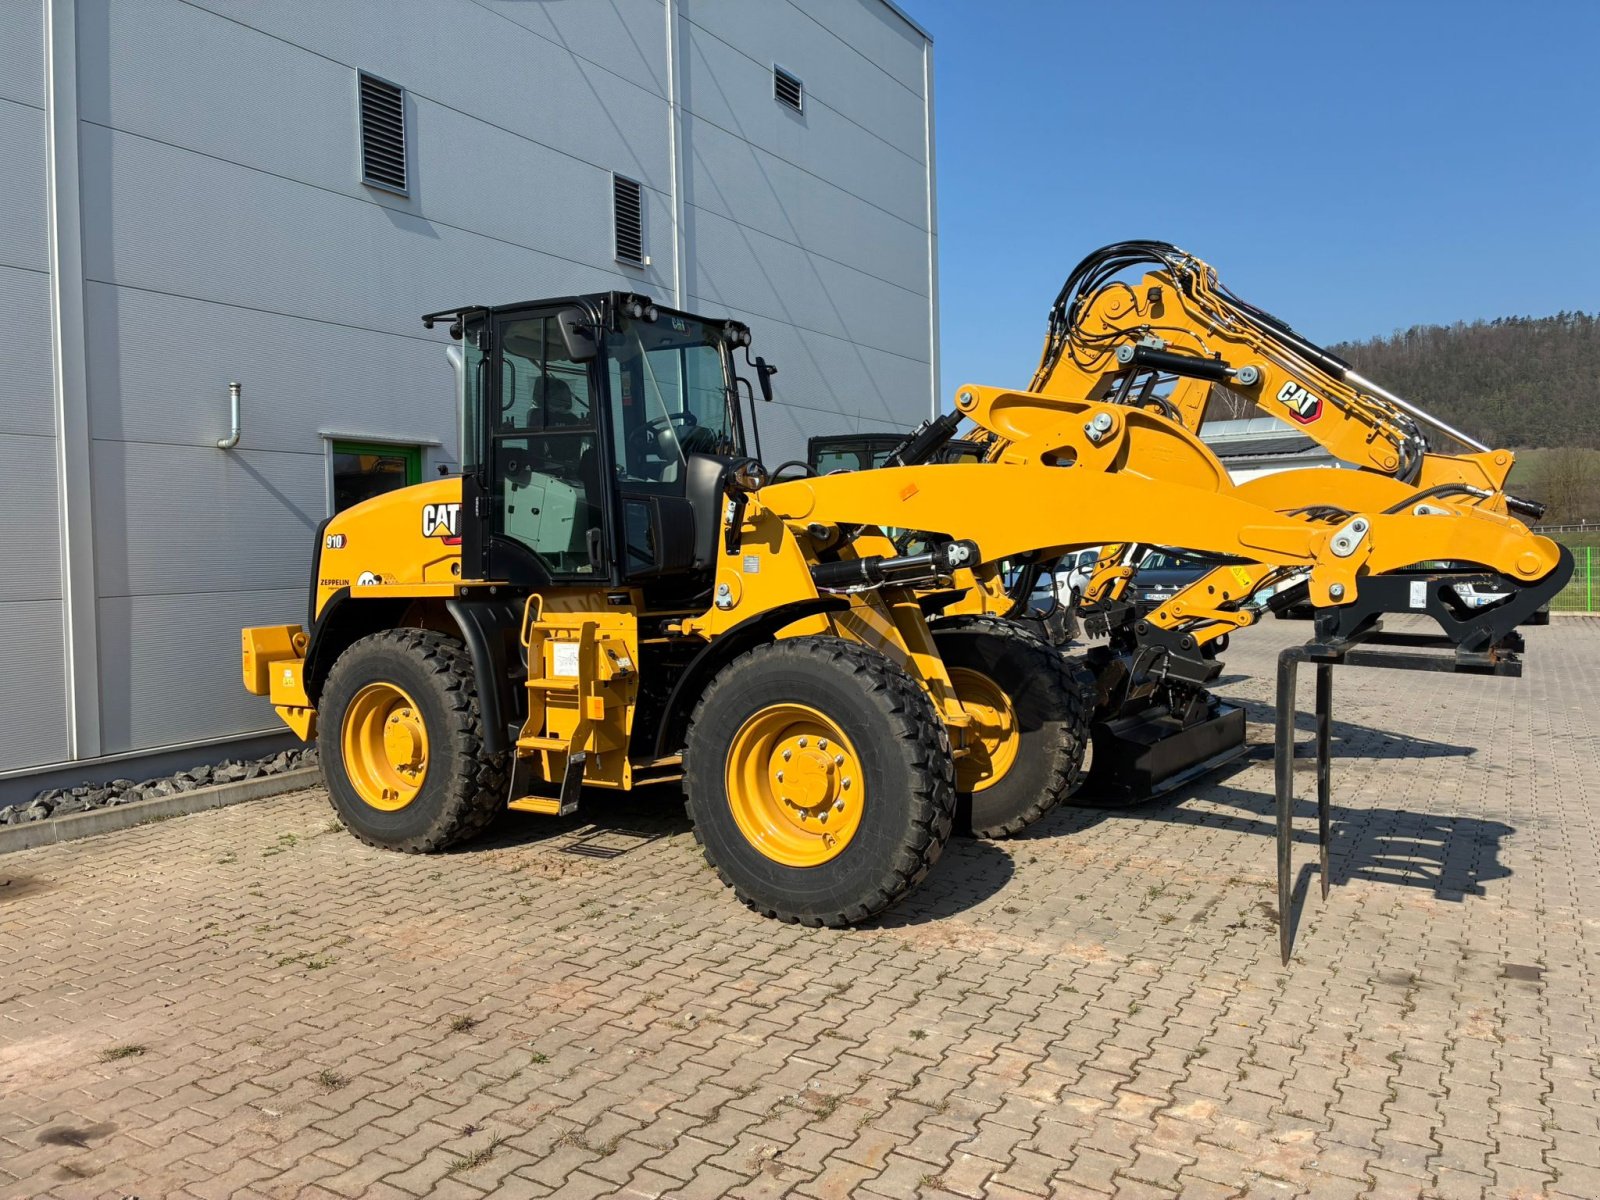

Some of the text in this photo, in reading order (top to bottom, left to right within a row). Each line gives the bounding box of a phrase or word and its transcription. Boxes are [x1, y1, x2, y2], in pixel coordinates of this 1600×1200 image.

[1276, 380, 1320, 416] CAT
[422, 503, 460, 537] CAT
[326, 534, 342, 549] 910
